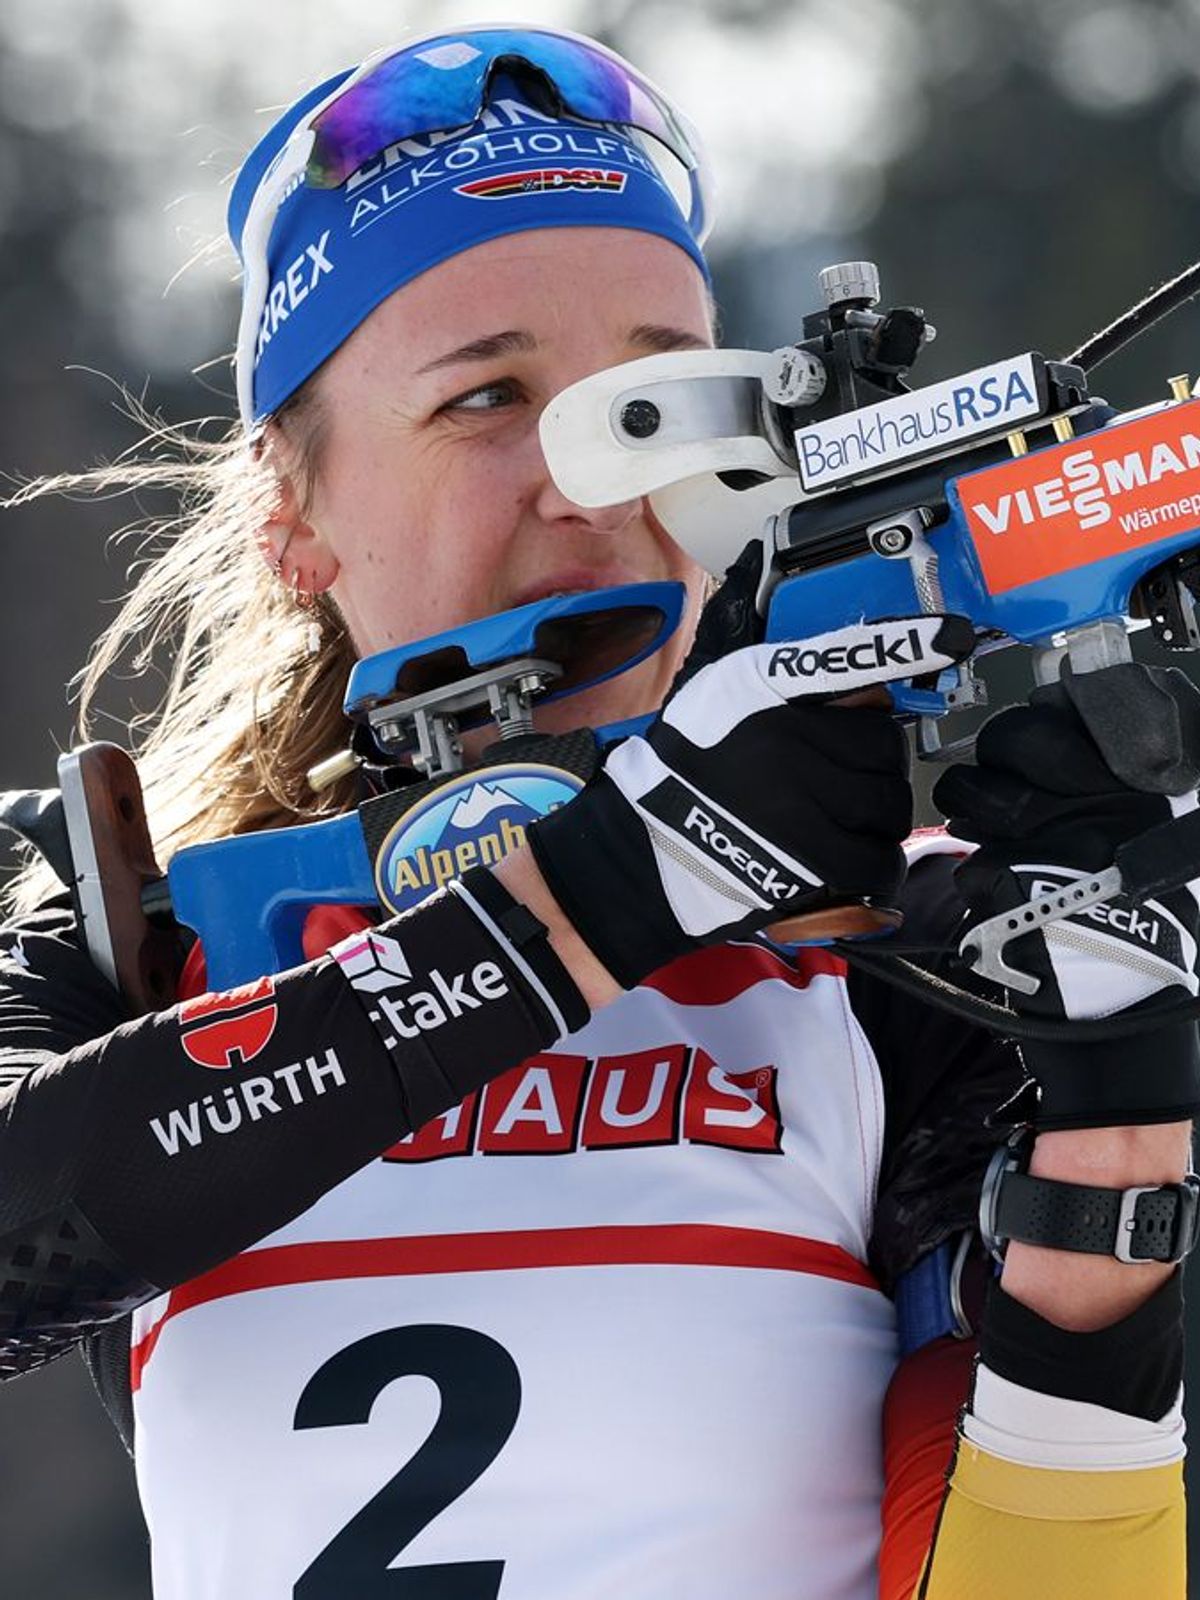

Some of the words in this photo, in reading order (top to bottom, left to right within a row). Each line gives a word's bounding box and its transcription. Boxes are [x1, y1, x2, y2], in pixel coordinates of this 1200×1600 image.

[350, 132, 656, 228] ALKOHOLFR
[542, 166, 627, 193] DSV
[255, 229, 334, 369] RREX
[800, 371, 1034, 478] BankhausRSA
[394, 804, 557, 896] Alpenh
[368, 961, 510, 1051] take
[149, 1047, 347, 1157] WÜRTH
[292, 1322, 523, 1600] 2
